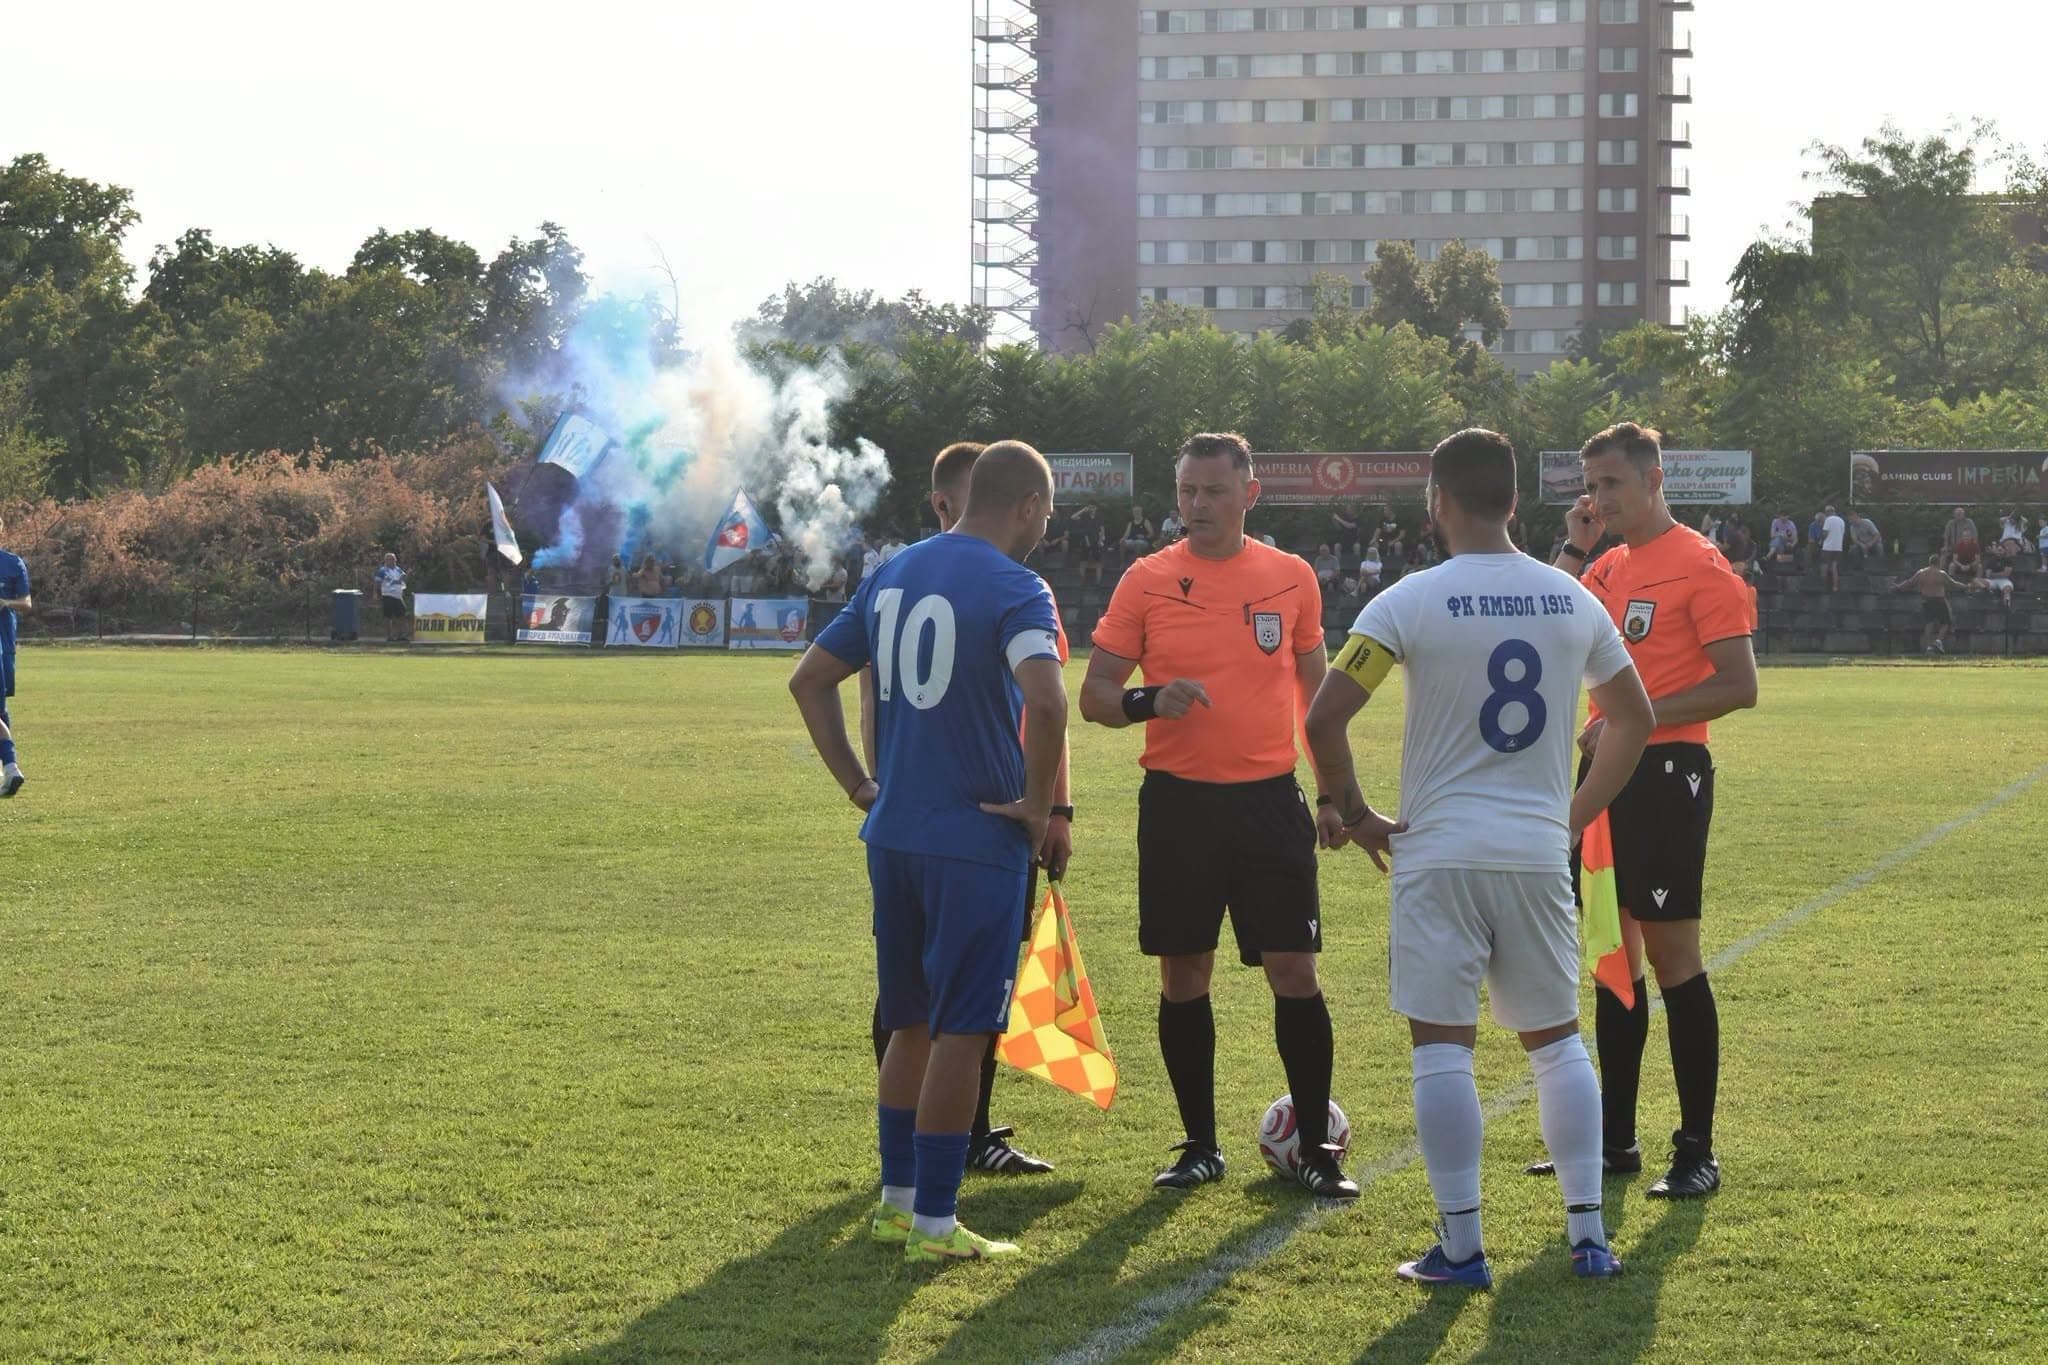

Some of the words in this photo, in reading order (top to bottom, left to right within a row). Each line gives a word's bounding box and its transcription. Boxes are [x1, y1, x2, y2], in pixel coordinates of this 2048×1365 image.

[1053, 457, 1112, 468] МЕДИЦИНА
[1253, 462, 1312, 474] IMPERIA
[1358, 462, 1420, 474] TECHNO
[1663, 462, 1694, 478] ска
[1695, 465, 1748, 482] среща
[1881, 472, 1920, 481] GAMING
[1921, 472, 1953, 481] CLUBS
[1956, 465, 2041, 486] IMPERIA
[1446, 595, 1475, 618] ФК
[1478, 595, 1537, 617] ЯМБОЛ
[1540, 594, 1574, 616] 1915
[874, 588, 956, 710] 10
[1353, 648, 1371, 672] JAKO
[1479, 638, 1547, 754] 8
[996, 979, 1014, 1023] 1
